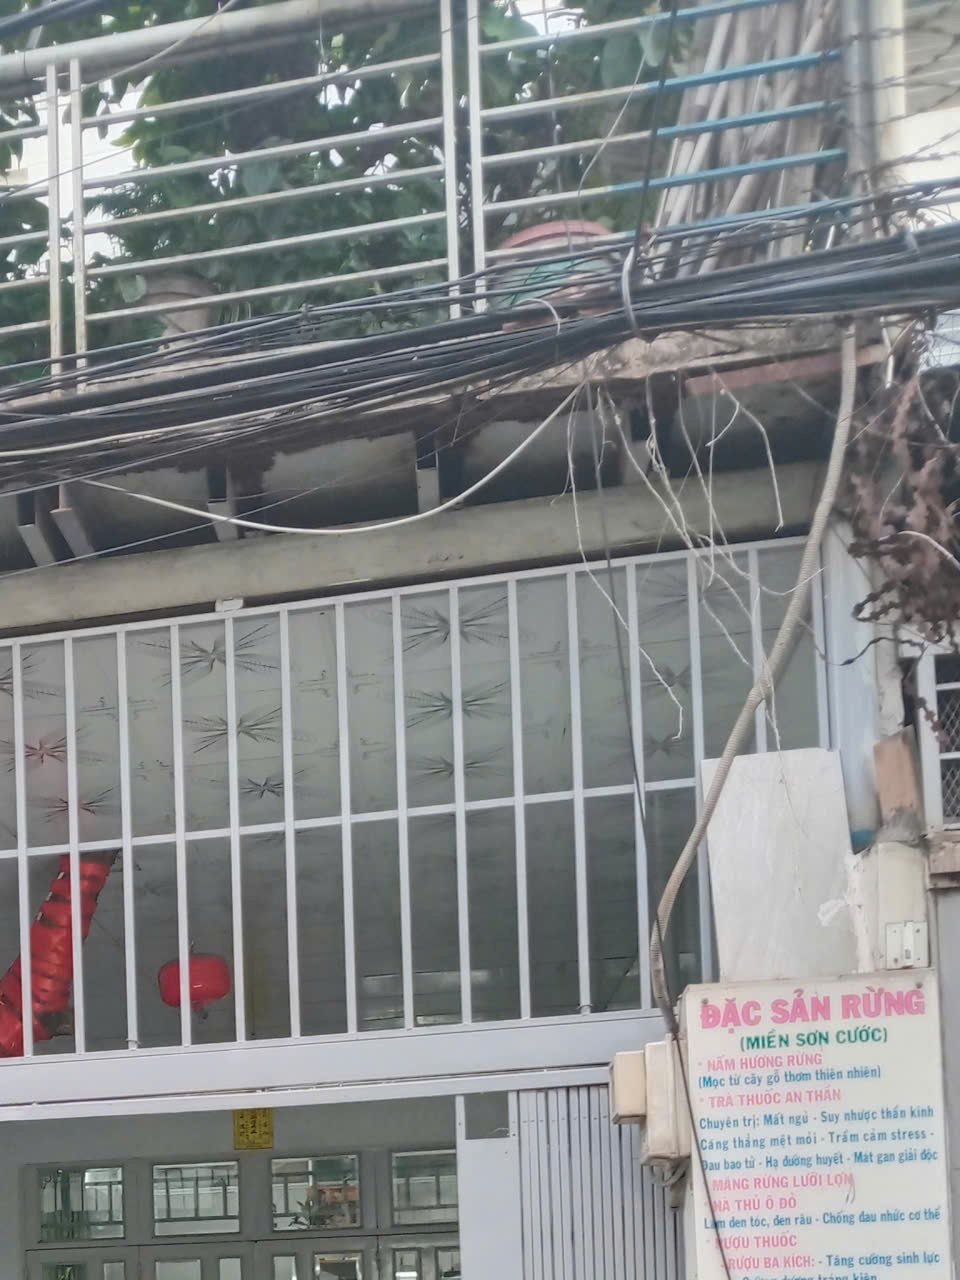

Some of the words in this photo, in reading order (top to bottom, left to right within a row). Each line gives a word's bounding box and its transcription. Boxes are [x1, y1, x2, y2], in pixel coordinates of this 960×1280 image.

[700, 998, 761, 1034] ĐẶC
[771, 988, 830, 1024] SẢN
[841, 986, 925, 1020] RỪNG
[796, 1030, 829, 1047] SƠN
[836, 1025, 888, 1044] CƯỚC)
[740, 1055, 783, 1070] HƯƠNG
[784, 1070, 811, 1083] thơm
[815, 1068, 843, 1081] thiên
[785, 1091, 802, 1104] AN
[700, 1117, 739, 1131] Chuyên
[763, 1112, 784, 1126] Mất
[820, 1111, 840, 1124] Suy
[891, 1129, 927, 1141] stress
[766, 1156, 778, 1171] Hạ
[877, 1152, 895, 1165] gan
[822, 1210, 855, 1225] Chống
[764, 1257, 779, 1269] BA
[897, 1251, 919, 1264] sinh
